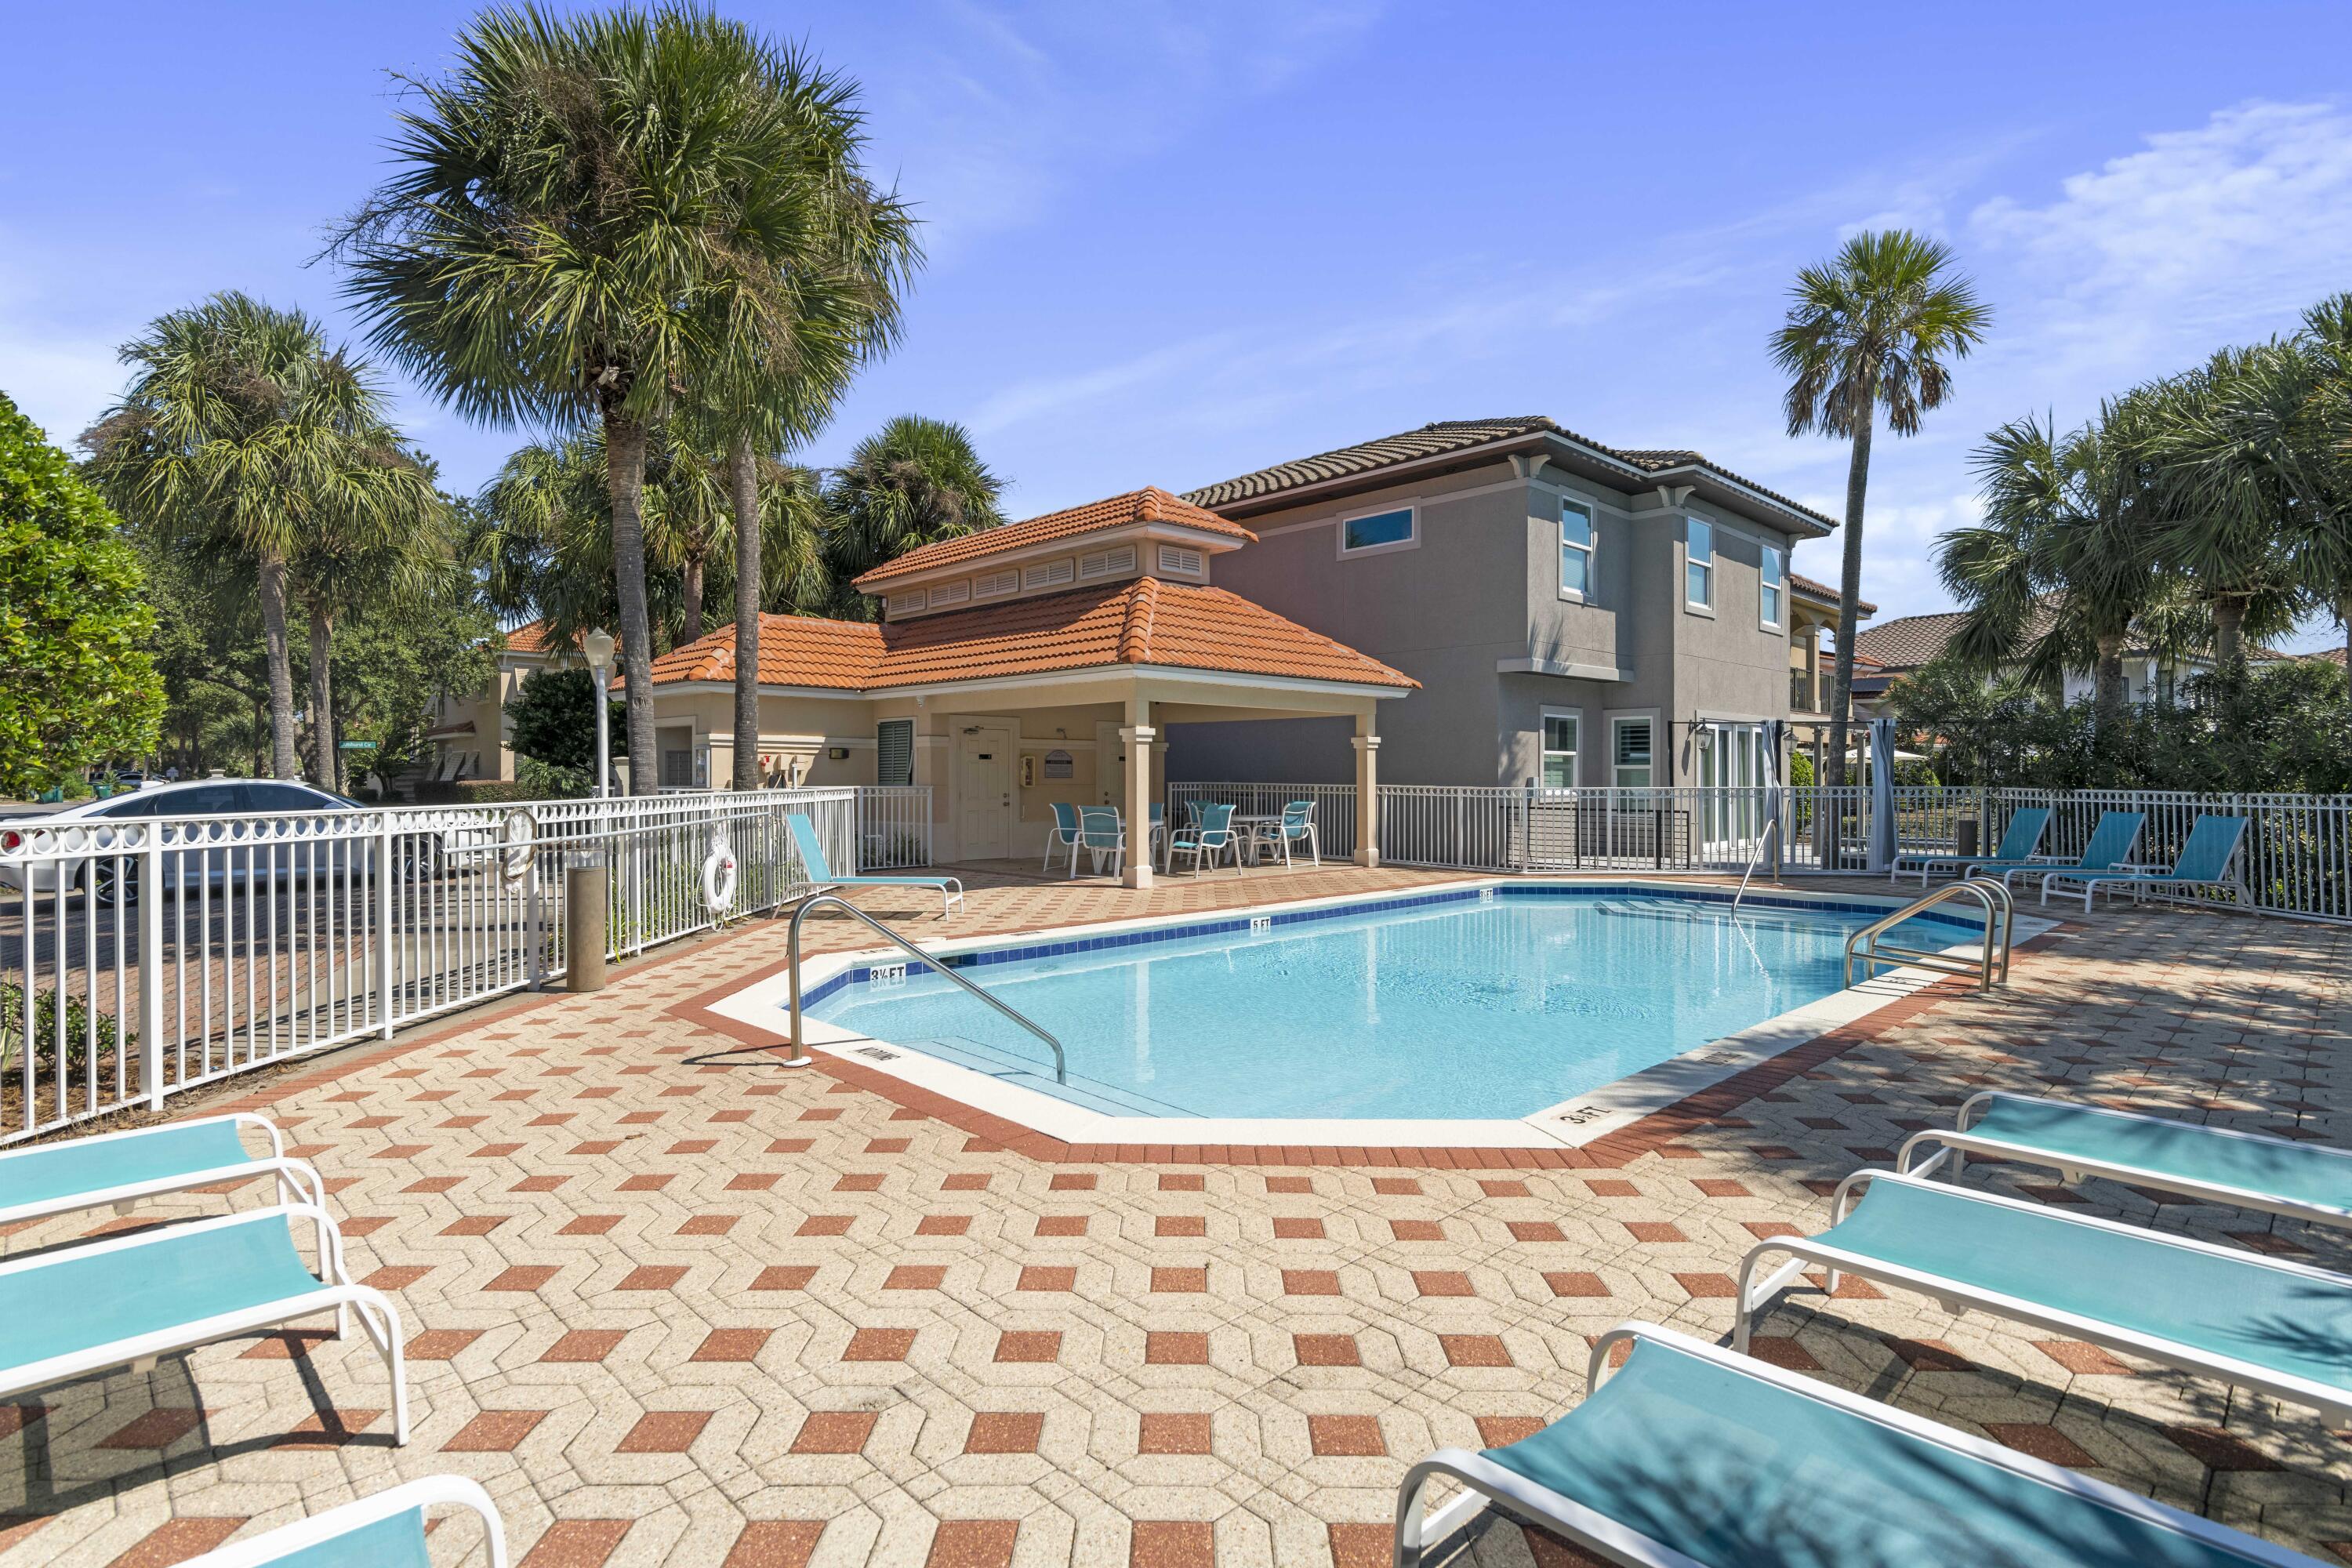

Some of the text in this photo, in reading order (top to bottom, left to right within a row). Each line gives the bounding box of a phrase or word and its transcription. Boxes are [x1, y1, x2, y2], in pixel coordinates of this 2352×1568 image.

[1253, 918, 1270, 928] 5 FT
[889, 966, 905, 978] FT
[1575, 1106, 1613, 1117] FT
